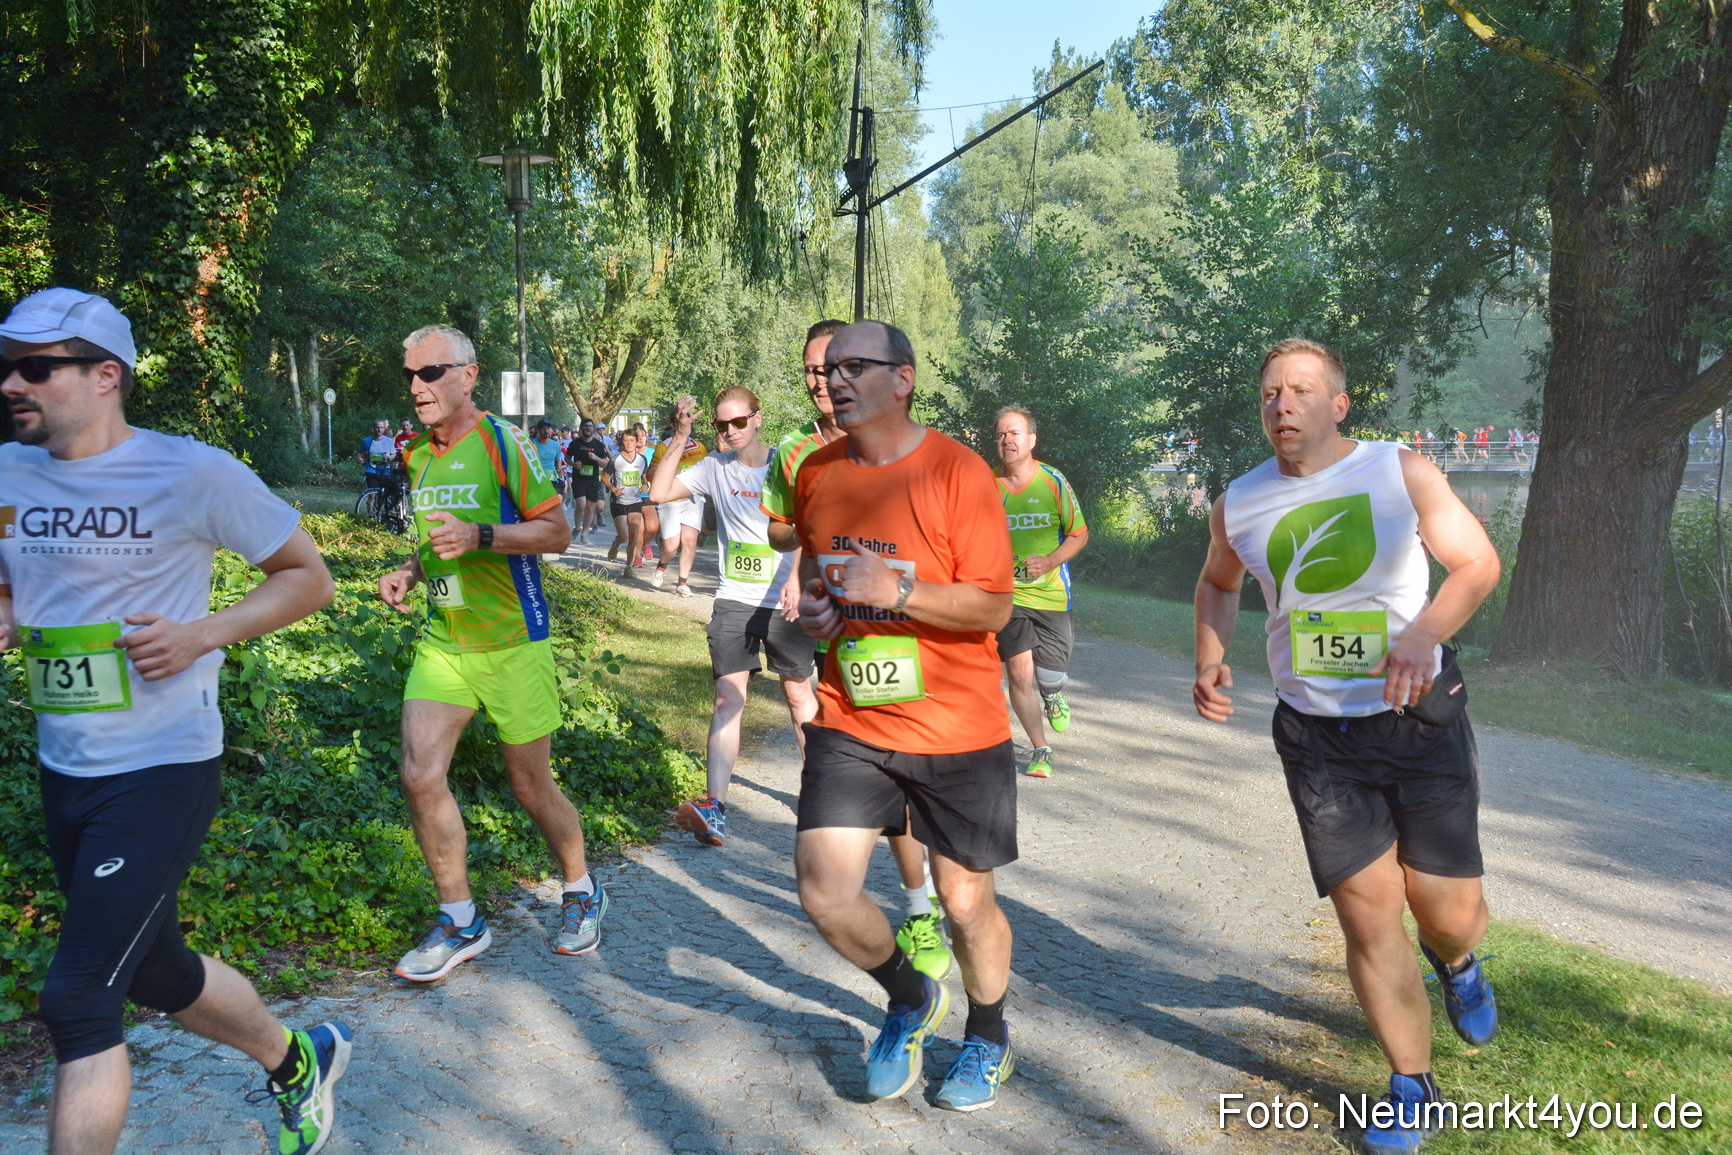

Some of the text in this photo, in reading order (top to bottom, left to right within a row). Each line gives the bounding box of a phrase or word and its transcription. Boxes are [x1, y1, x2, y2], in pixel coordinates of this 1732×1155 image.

[741, 490, 761, 498] KLE
[21, 506, 153, 539] GRADL
[1006, 513, 1052, 530] OCK
[21, 546, 154, 555] HOLZKREATIONEN
[734, 555, 762, 573] 898
[1312, 634, 1366, 660] 154
[1310, 658, 1369, 668] Fesseler Jochen
[36, 656, 94, 690] 731
[850, 661, 900, 686] 902
